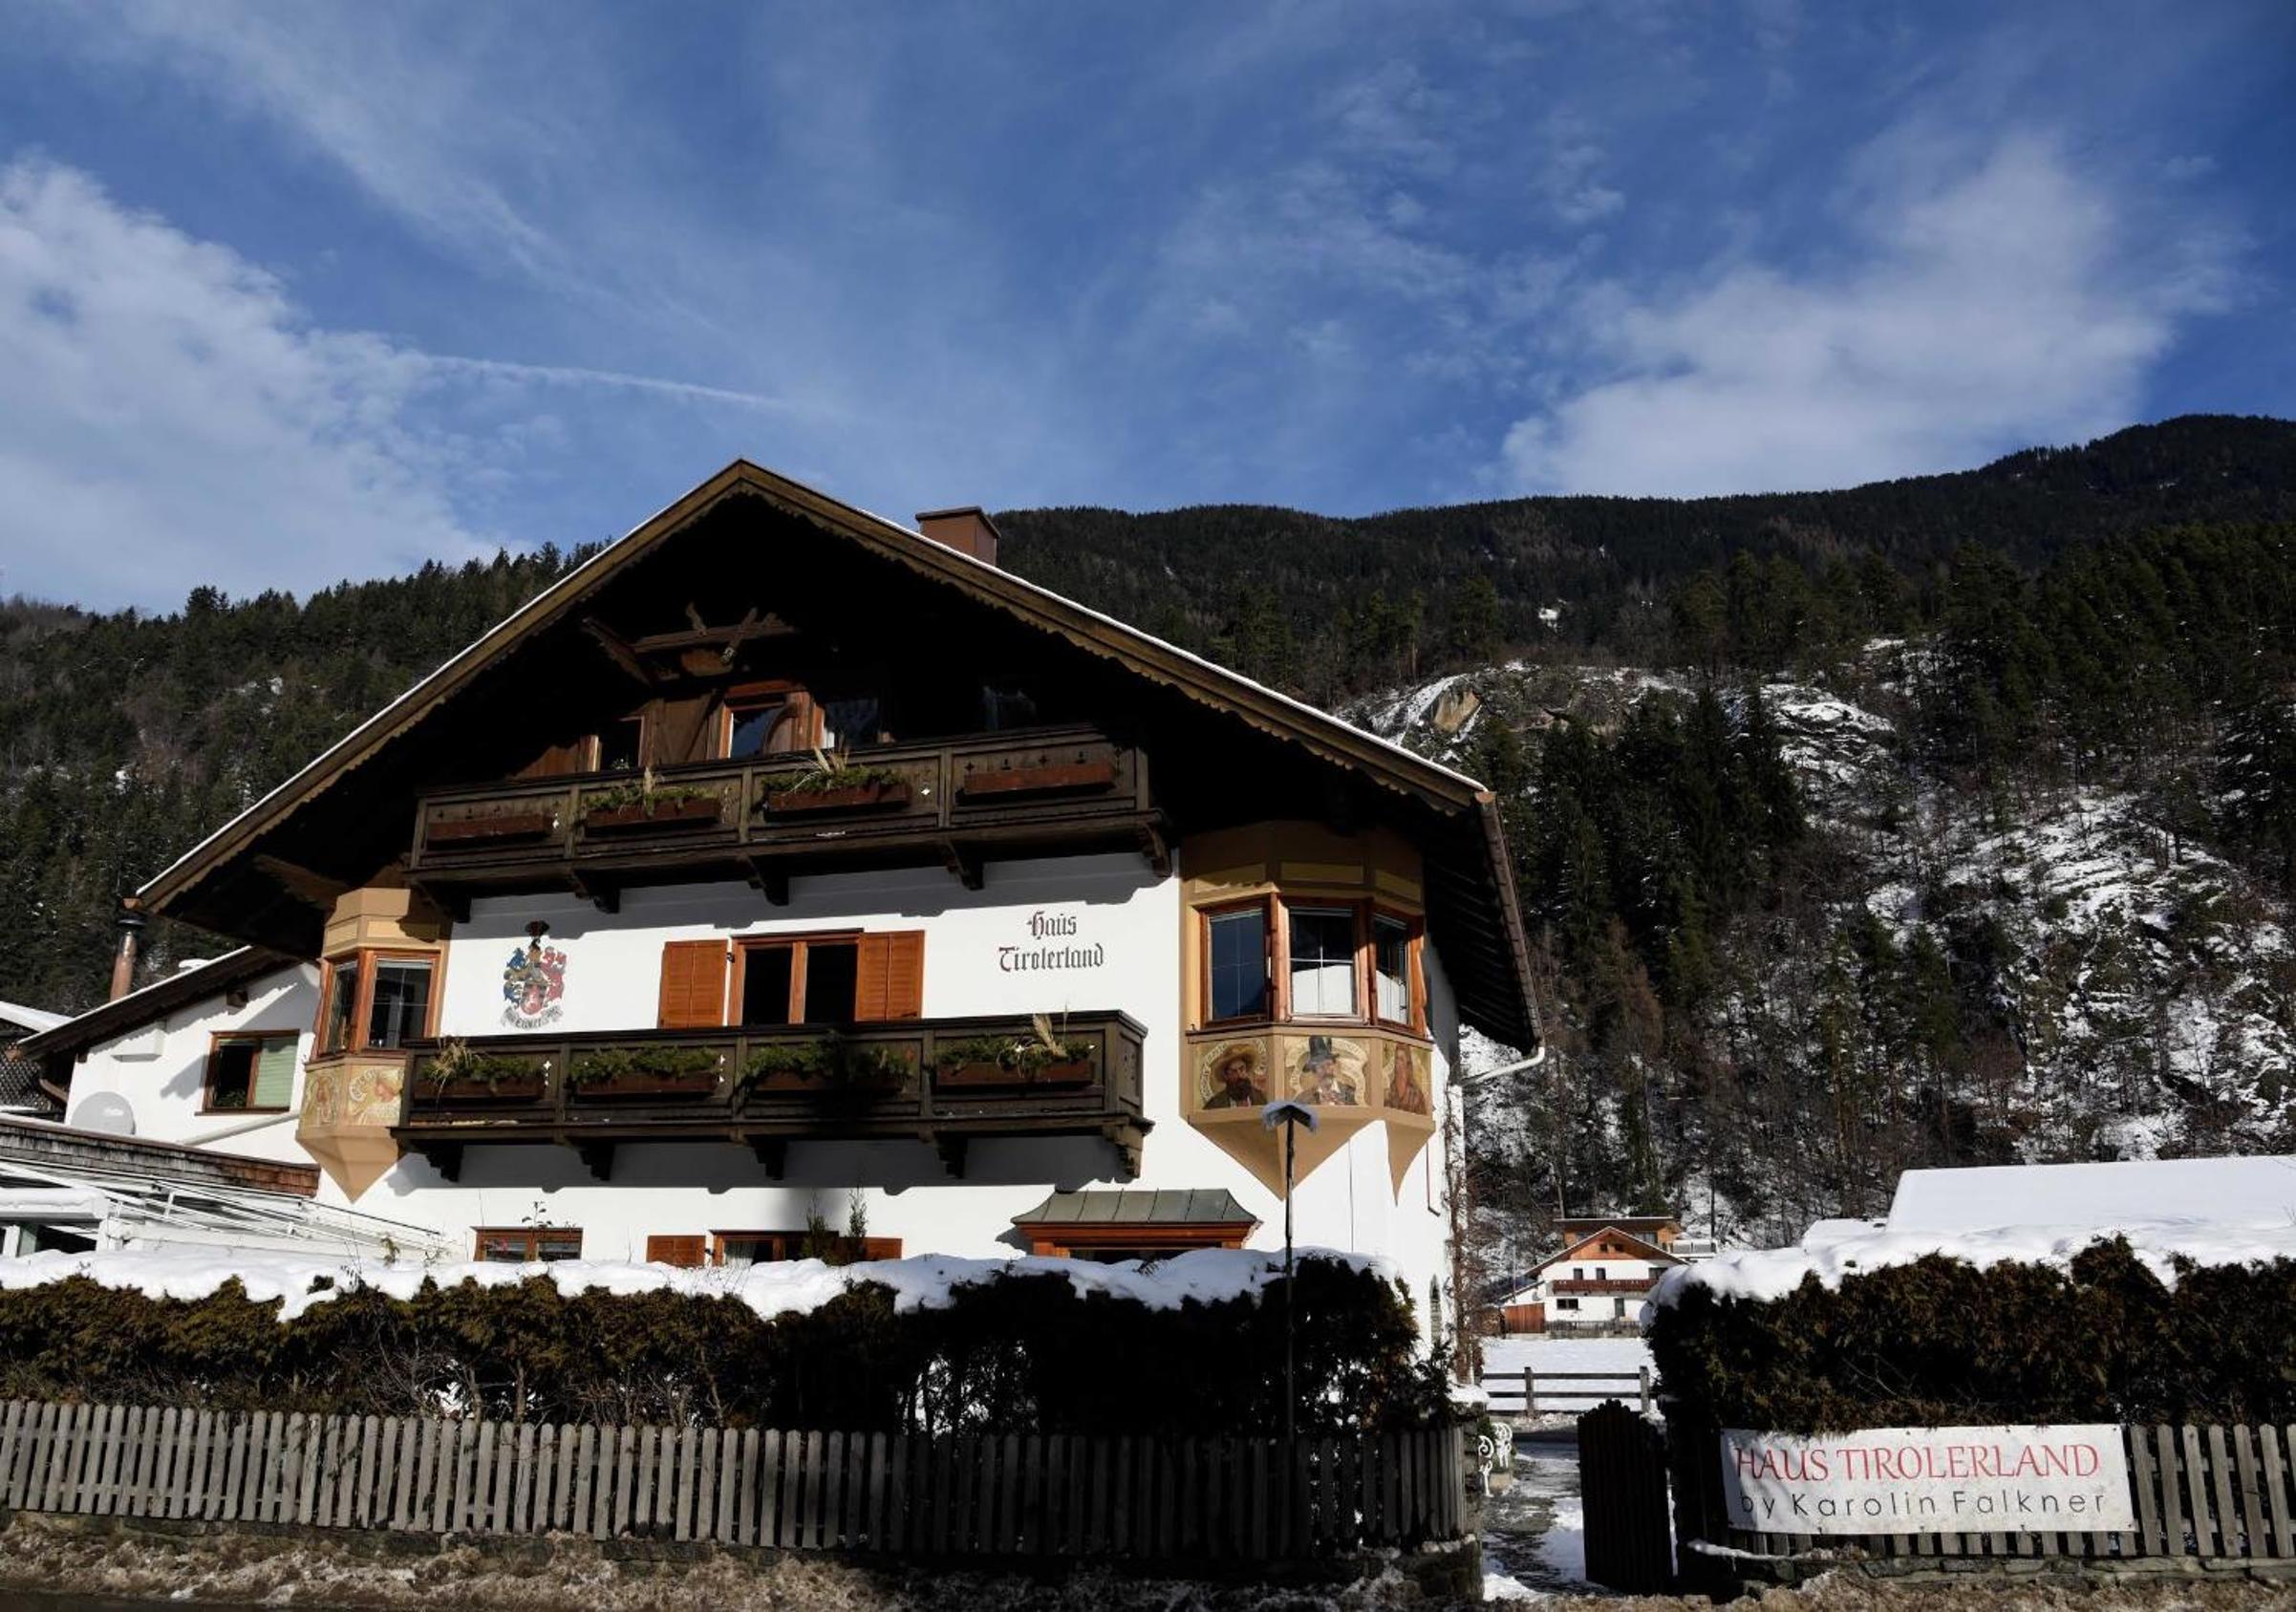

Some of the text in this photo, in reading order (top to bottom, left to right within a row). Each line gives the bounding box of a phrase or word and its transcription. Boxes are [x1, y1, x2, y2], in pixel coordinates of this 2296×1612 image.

[998, 942, 1104, 972] Tirolerland
[1735, 1444, 2099, 1481] HAUS TIROLERLAND
[1739, 1489, 2104, 1519] by Karolin Falkner
